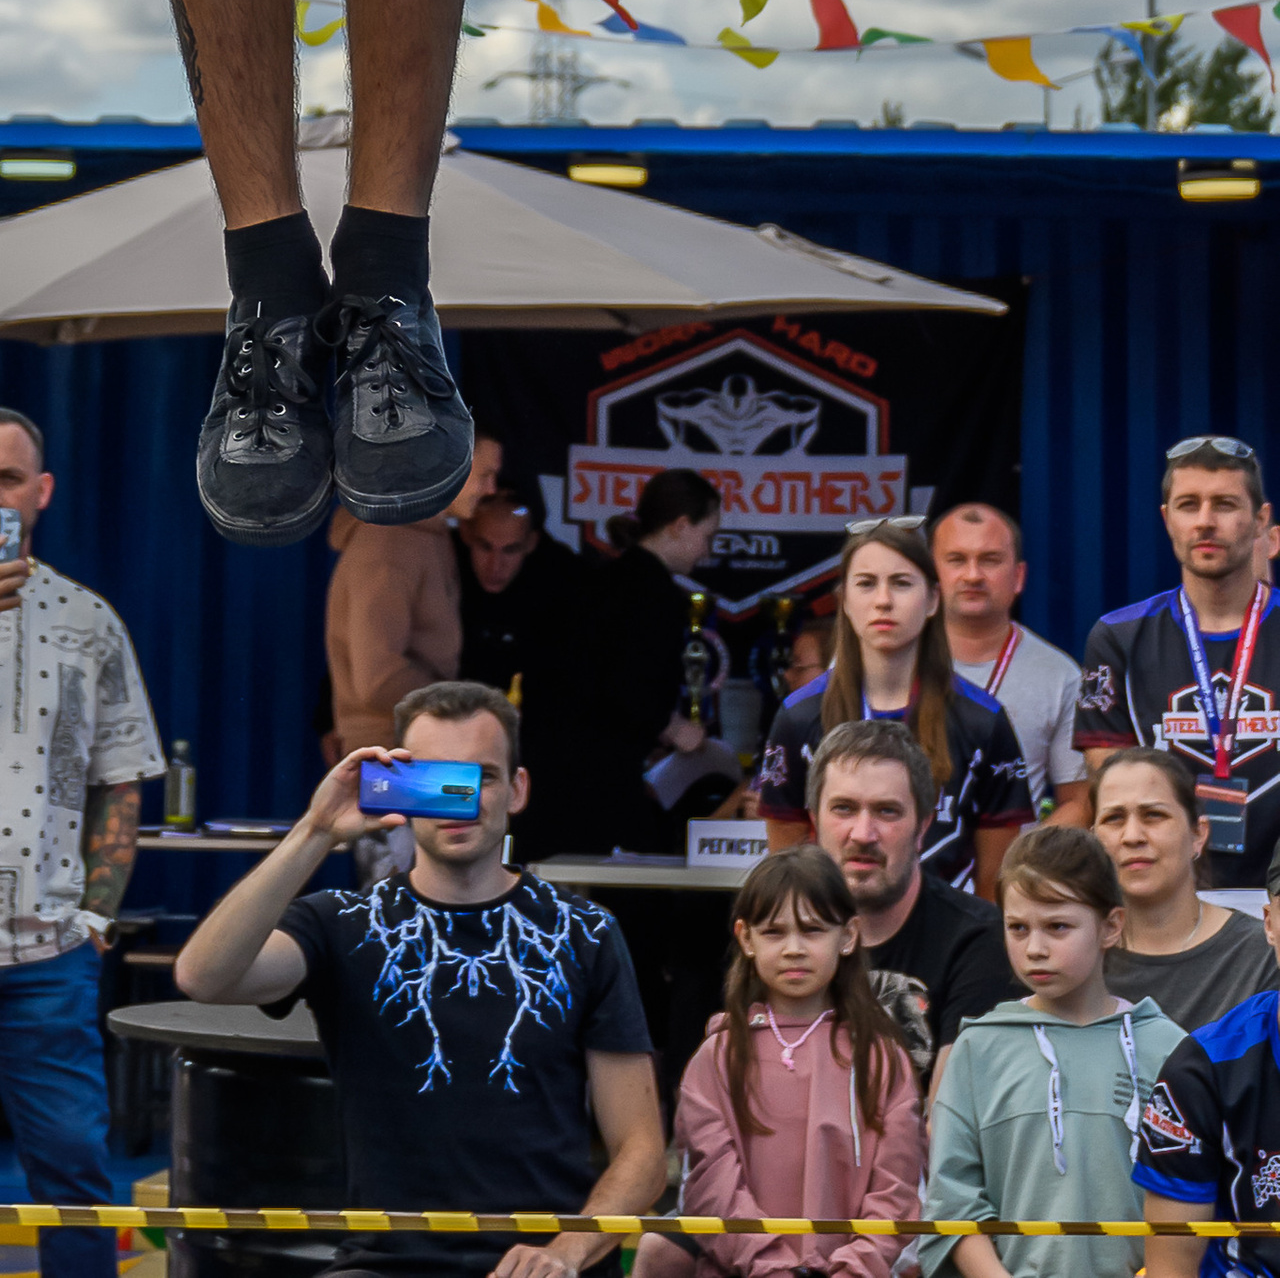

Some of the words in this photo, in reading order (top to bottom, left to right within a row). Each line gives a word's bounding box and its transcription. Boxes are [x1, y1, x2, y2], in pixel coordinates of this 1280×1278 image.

[771, 314, 879, 379] HARD
[711, 533, 781, 556] EAM
[1164, 716, 1206, 734] STEEL
